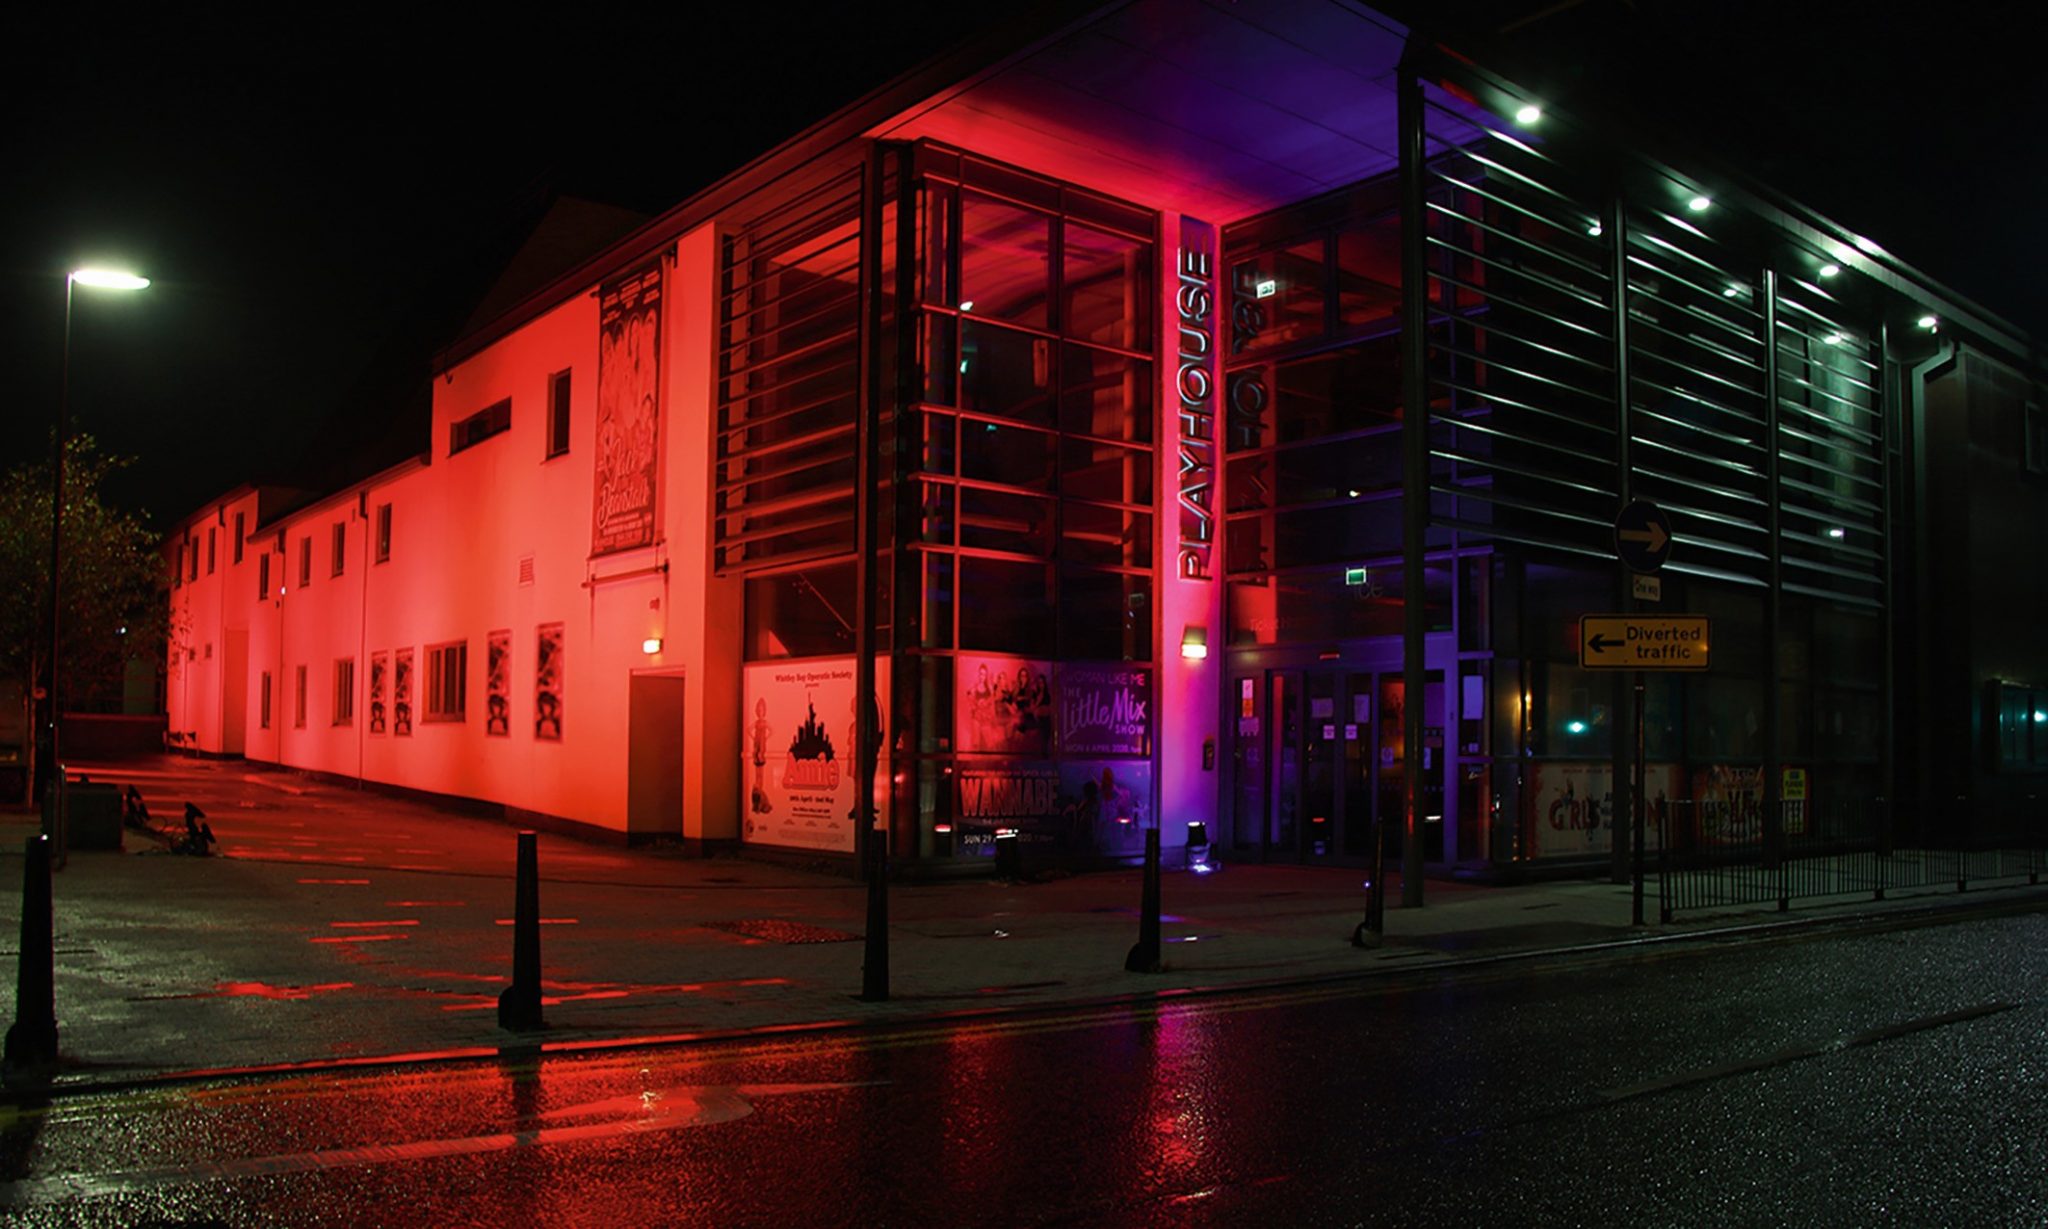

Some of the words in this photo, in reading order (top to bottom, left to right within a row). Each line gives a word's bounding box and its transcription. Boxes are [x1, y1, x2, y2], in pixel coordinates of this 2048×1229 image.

[1176, 247, 1214, 583] PLAYHOUSE
[1626, 626, 1700, 642] Diverted
[1637, 644, 1691, 660] traffic
[831, 670, 853, 680] Society
[1130, 672, 1146, 687] ME
[1063, 686, 1081, 698] THE
[1063, 690, 1111, 741] Little
[1108, 687, 1147, 731] Mix
[1115, 724, 1146, 736] SHOW
[960, 777, 1060, 817] WANNABE
[964, 834, 981, 845] SUN
